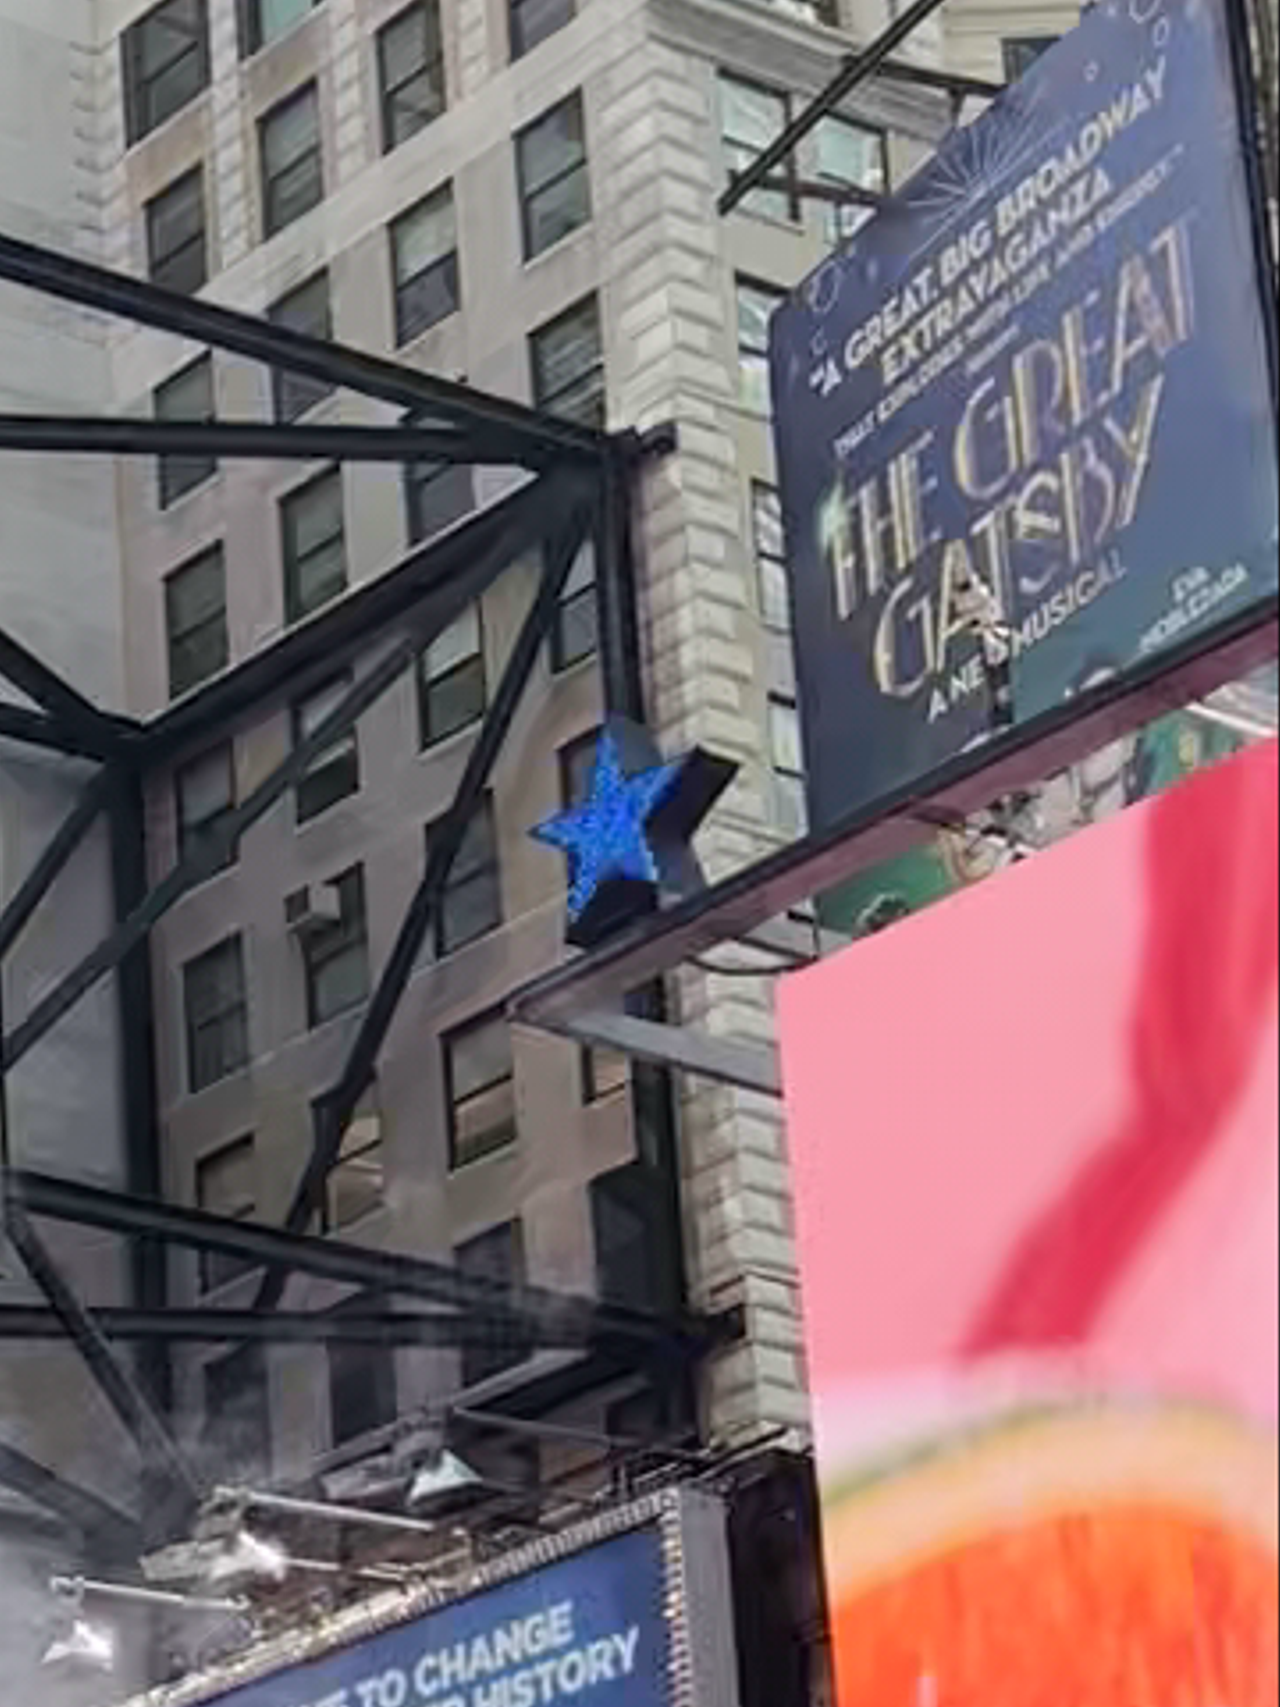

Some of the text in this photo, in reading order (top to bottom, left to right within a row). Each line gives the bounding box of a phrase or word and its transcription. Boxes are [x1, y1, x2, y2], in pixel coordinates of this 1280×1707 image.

[879, 165, 1114, 387] EXTRAVAGANZA
[938, 217, 993, 282] BIG
[994, 54, 1169, 234] BROADWAY
[826, 211, 1197, 622] THE GREAT
[872, 371, 1165, 699] GATSBY
[1011, 549, 1128, 657] MUSICAL
[413, 1598, 575, 1694] CHANGE
